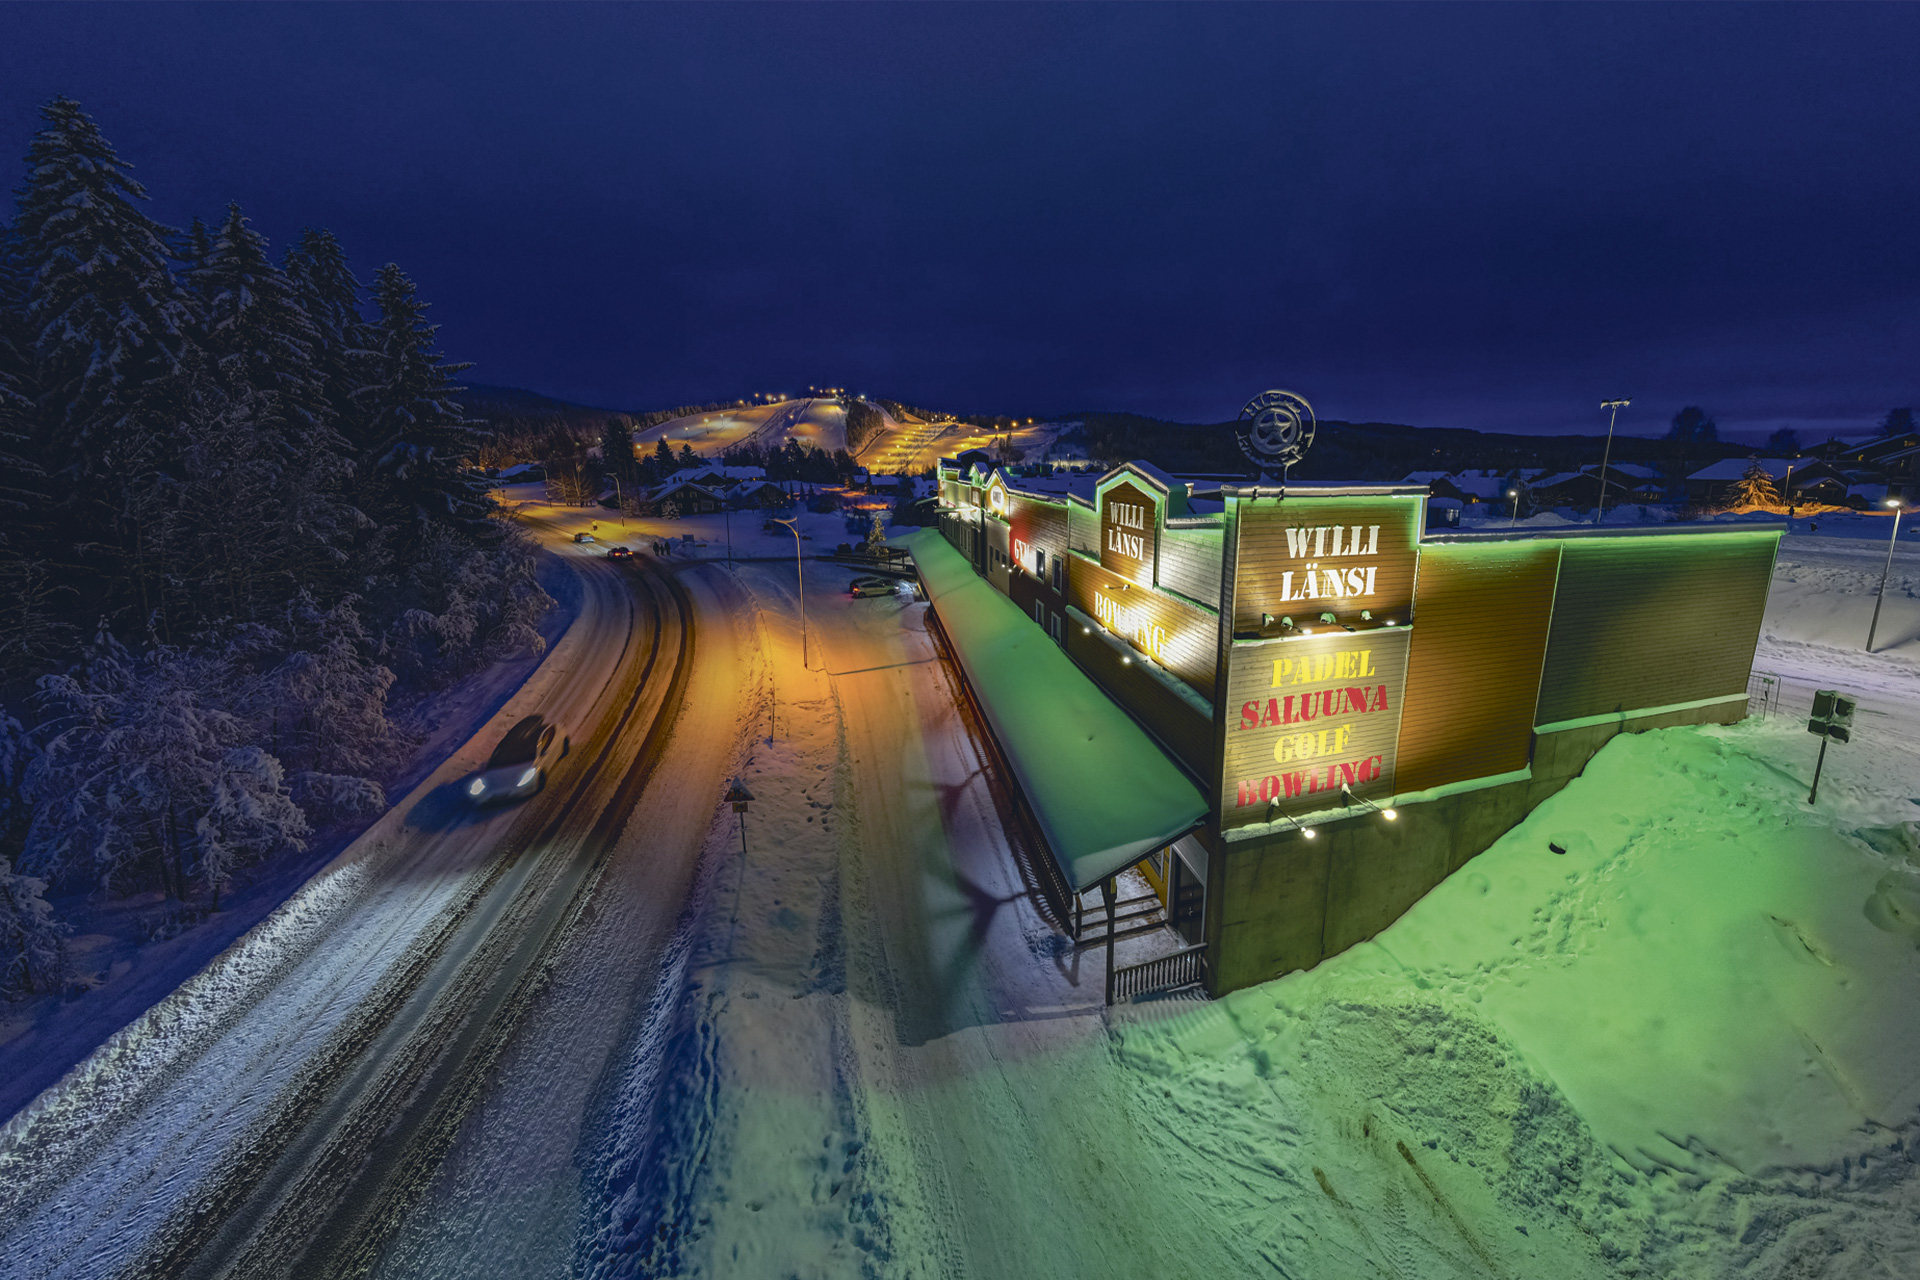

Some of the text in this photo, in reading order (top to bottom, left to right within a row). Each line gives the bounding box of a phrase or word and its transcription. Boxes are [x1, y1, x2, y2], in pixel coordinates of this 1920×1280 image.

[1110, 501, 1145, 530] WILLI
[1108, 526, 1144, 561] LÄNSI
[1285, 524, 1381, 559] WILLI
[1280, 563, 1378, 602] LÄNSI
[1094, 591, 1166, 658] BOWING
[1270, 649, 1376, 688] PADEL
[1240, 684, 1389, 730] SALUUNA
[1273, 723, 1352, 764] GOLF
[1235, 754, 1382, 808] BOWLING
